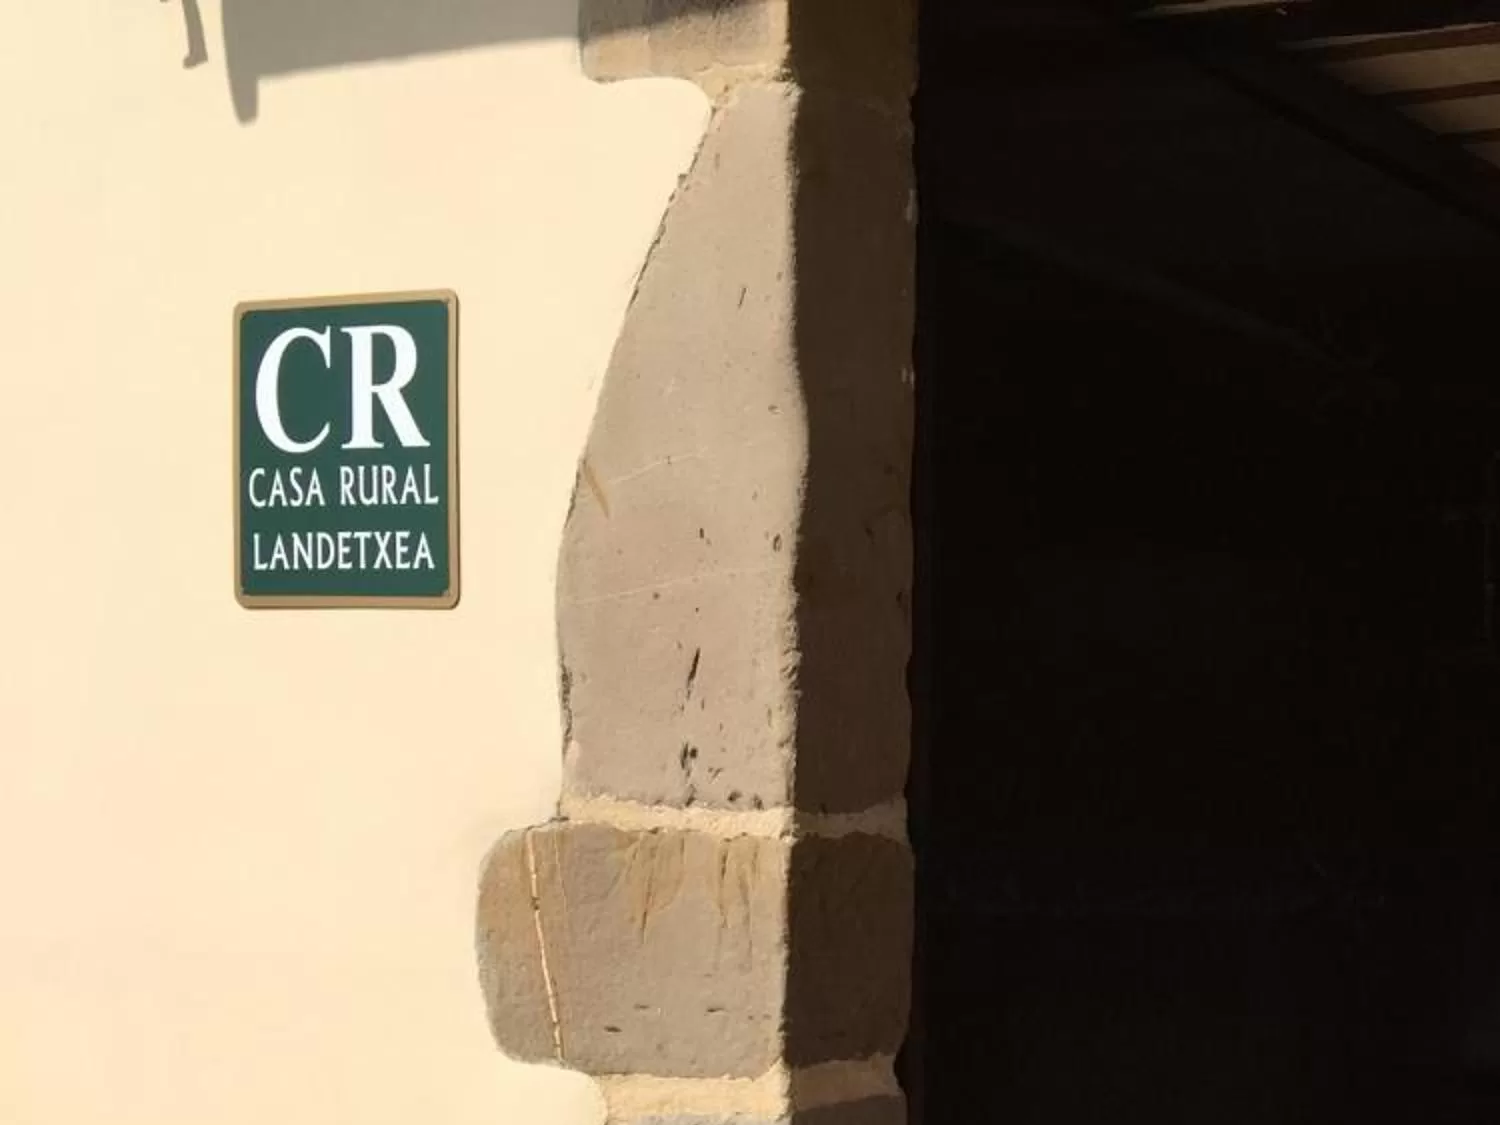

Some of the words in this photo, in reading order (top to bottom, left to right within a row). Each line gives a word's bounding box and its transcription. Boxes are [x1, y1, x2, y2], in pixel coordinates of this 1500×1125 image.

[255, 324, 431, 453] CR
[249, 467, 325, 507] CASA
[340, 463, 439, 505] RURAL
[253, 531, 435, 571] LANDETXEA
